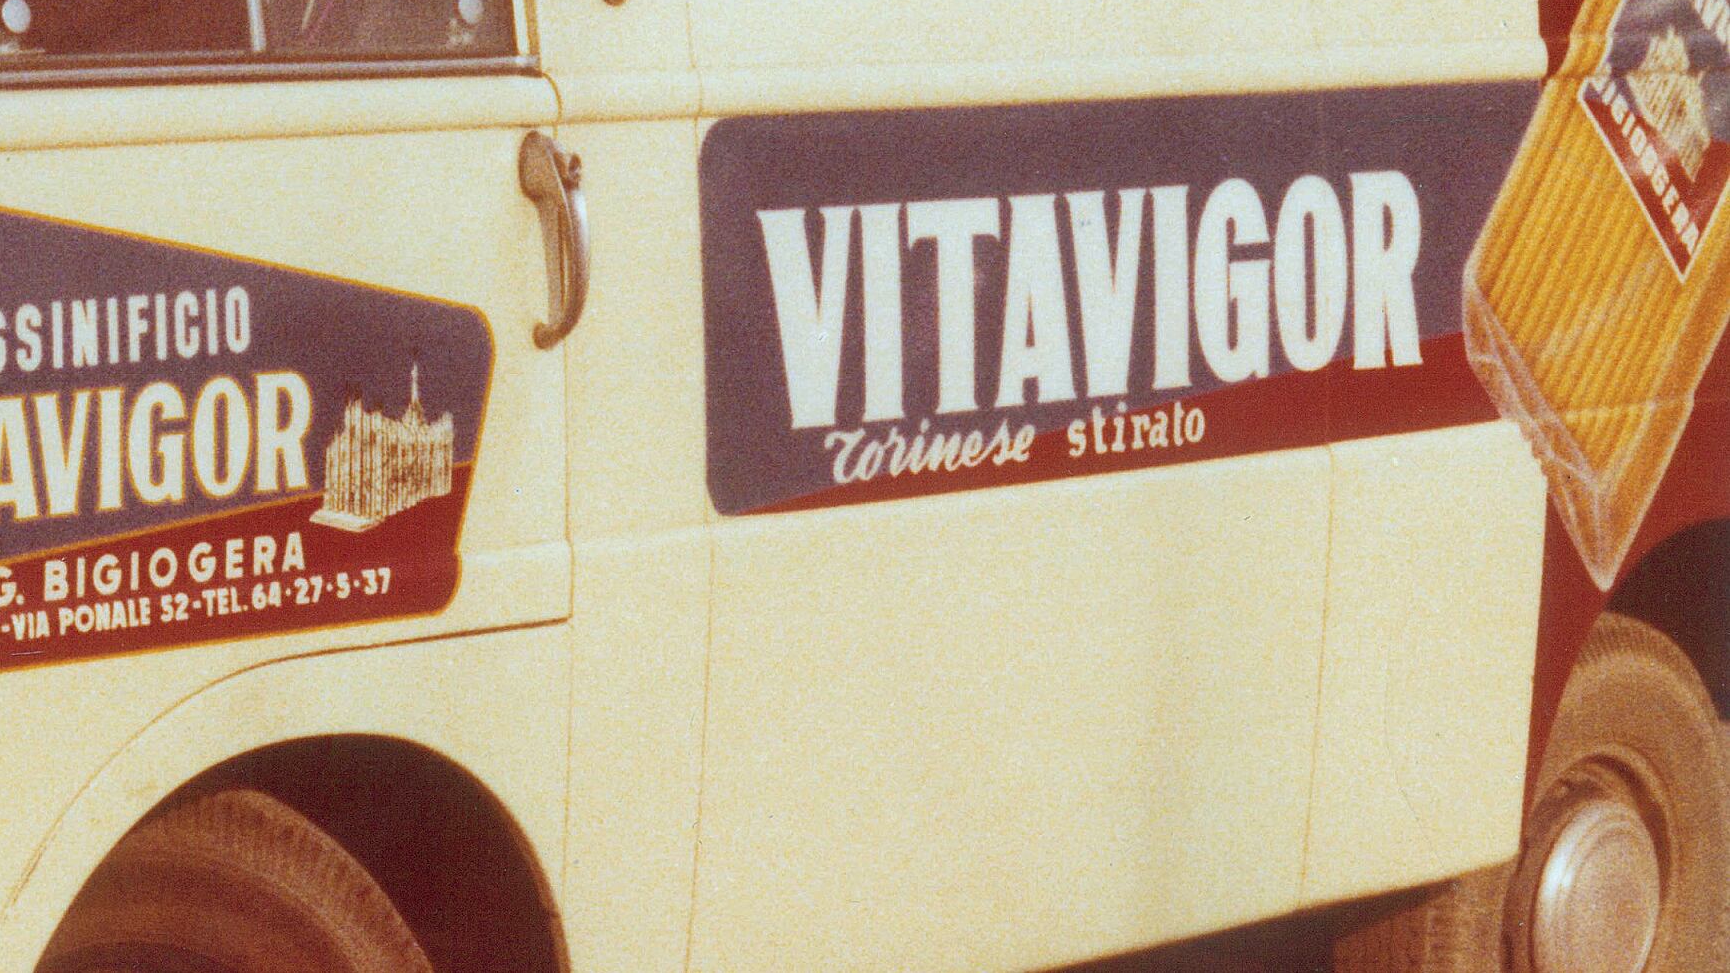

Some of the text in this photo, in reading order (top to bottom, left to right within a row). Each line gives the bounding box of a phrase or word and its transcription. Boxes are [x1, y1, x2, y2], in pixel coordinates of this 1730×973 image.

[755, 169, 1424, 431] VITAVIGOR
[824, 400, 1207, 485] Torinese stirato
[43, 531, 307, 602] BIGIOGERA
[57, 596, 152, 636] PONALE
